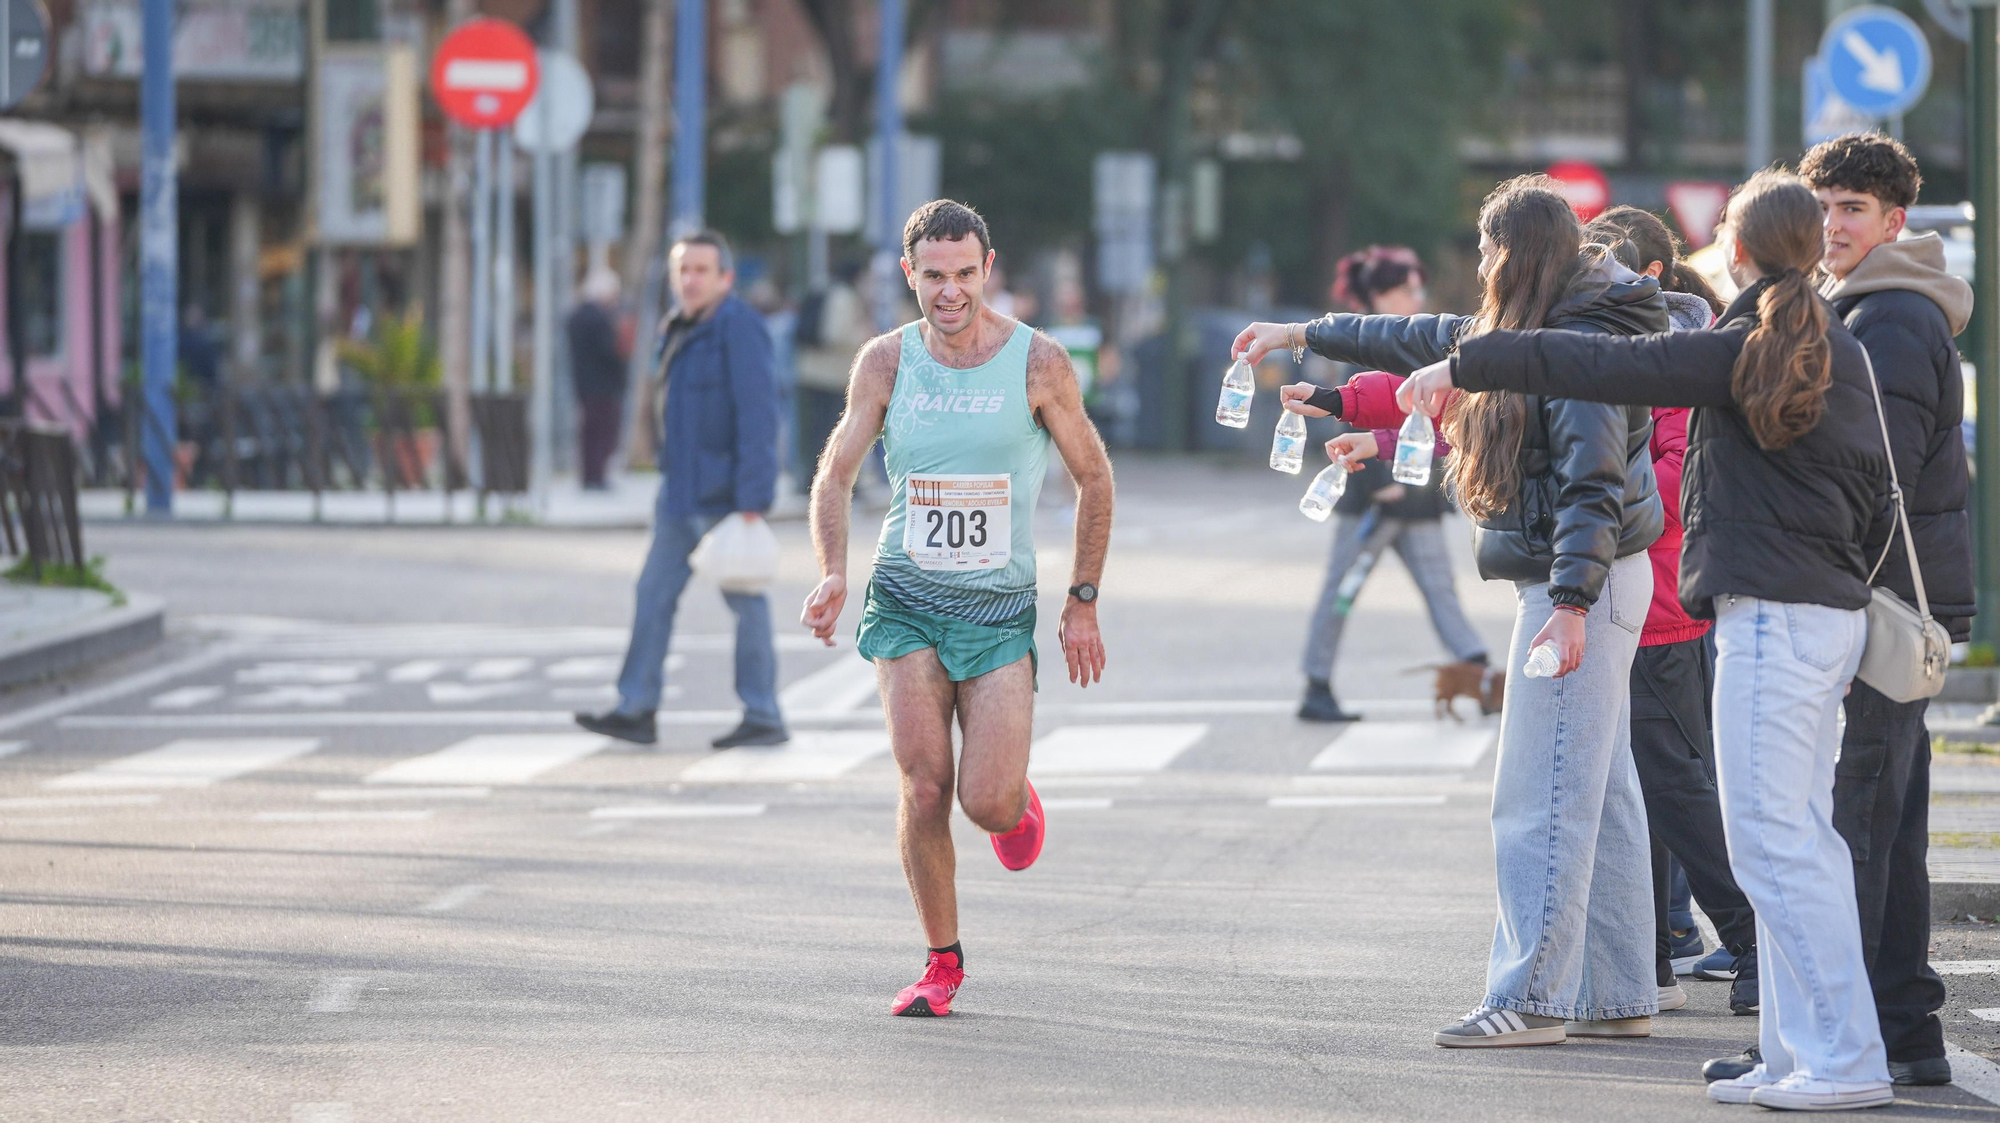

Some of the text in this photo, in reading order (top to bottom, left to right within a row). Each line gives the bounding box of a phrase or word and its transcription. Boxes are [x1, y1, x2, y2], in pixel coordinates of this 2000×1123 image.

[911, 393, 1005, 413] RAICES
[912, 480, 941, 506] XLII
[926, 509, 987, 548] 203
